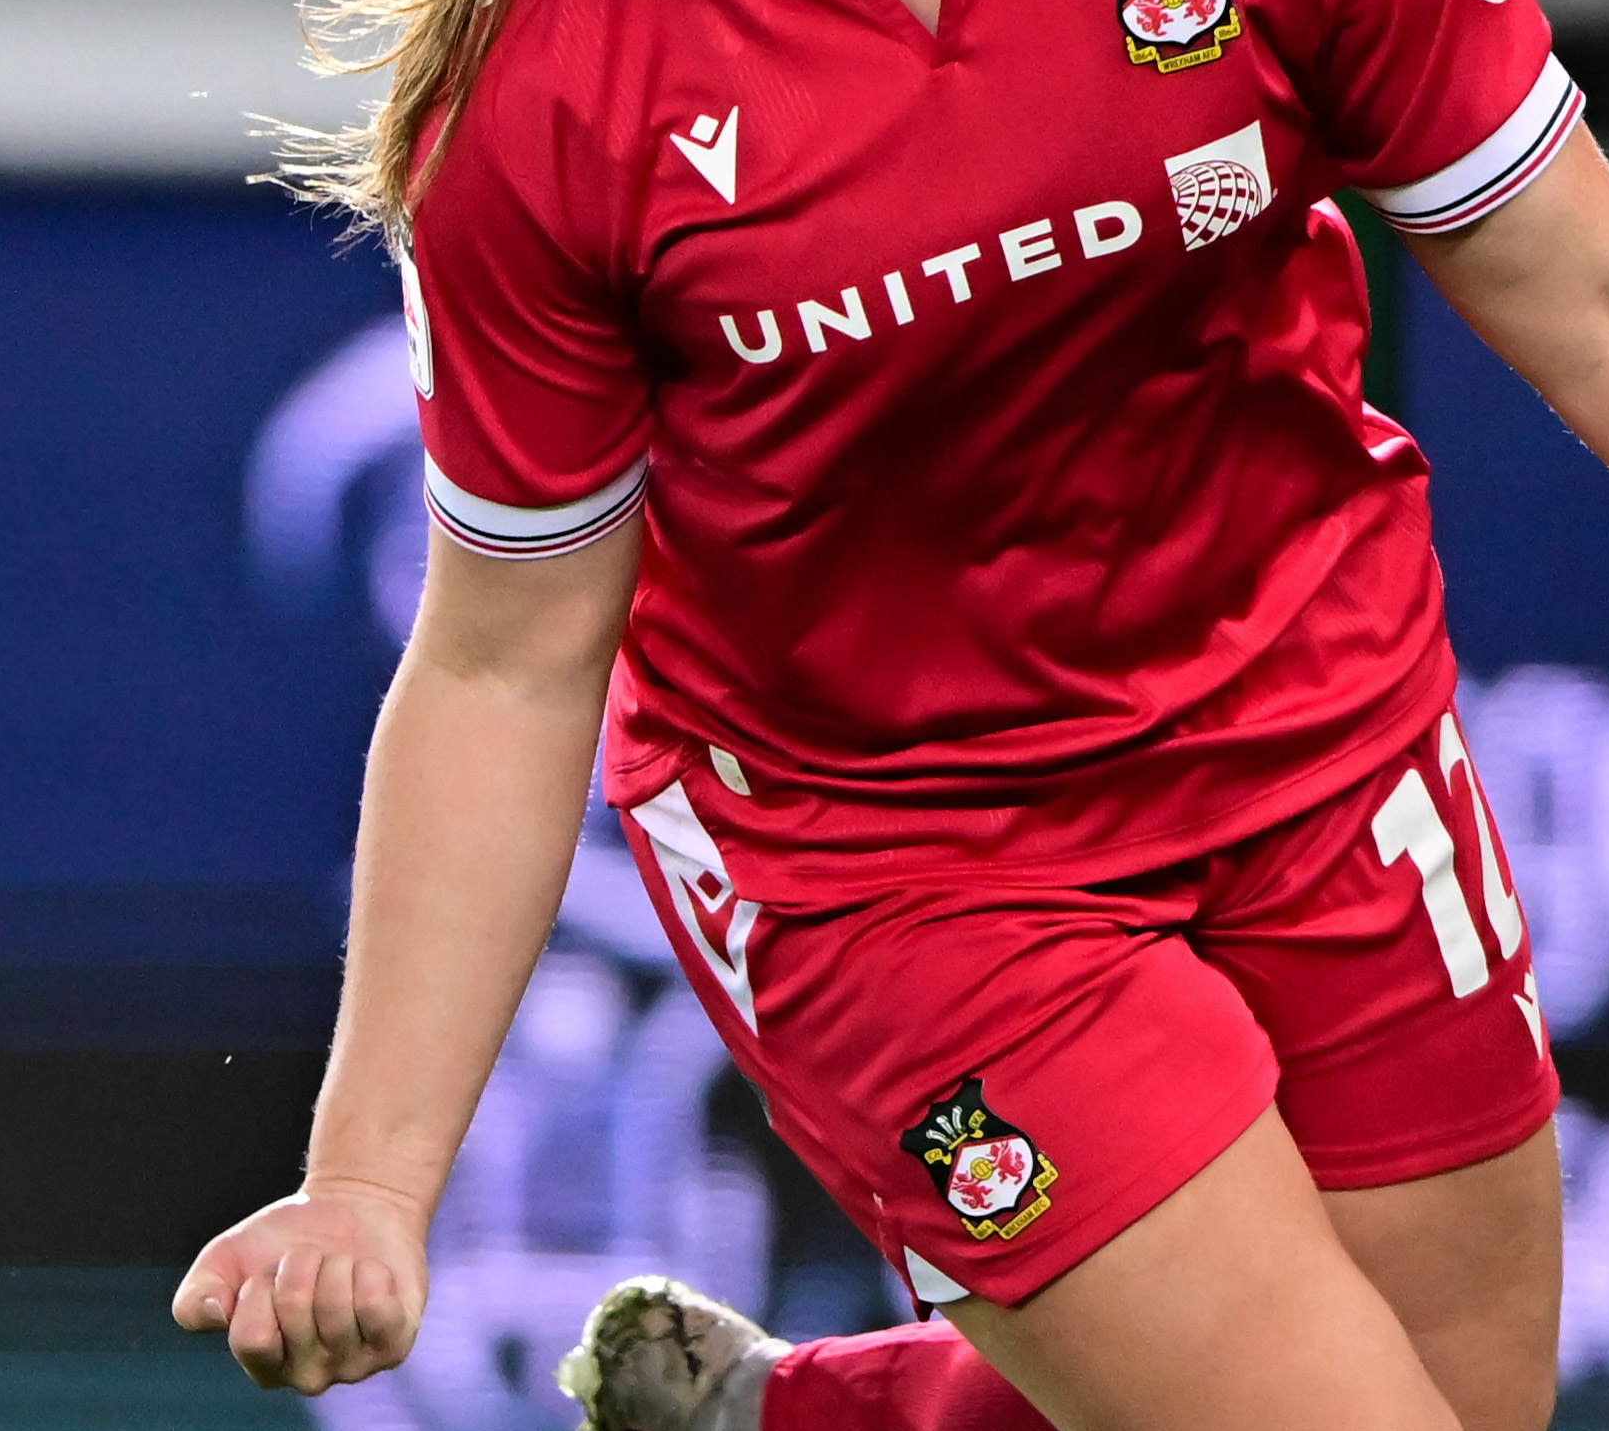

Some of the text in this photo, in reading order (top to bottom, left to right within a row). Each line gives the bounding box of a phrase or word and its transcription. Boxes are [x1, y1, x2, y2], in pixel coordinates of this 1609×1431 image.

[1163, 48, 1217, 70] WREXHAM AFC
[719, 181, 1143, 364] UNITED
